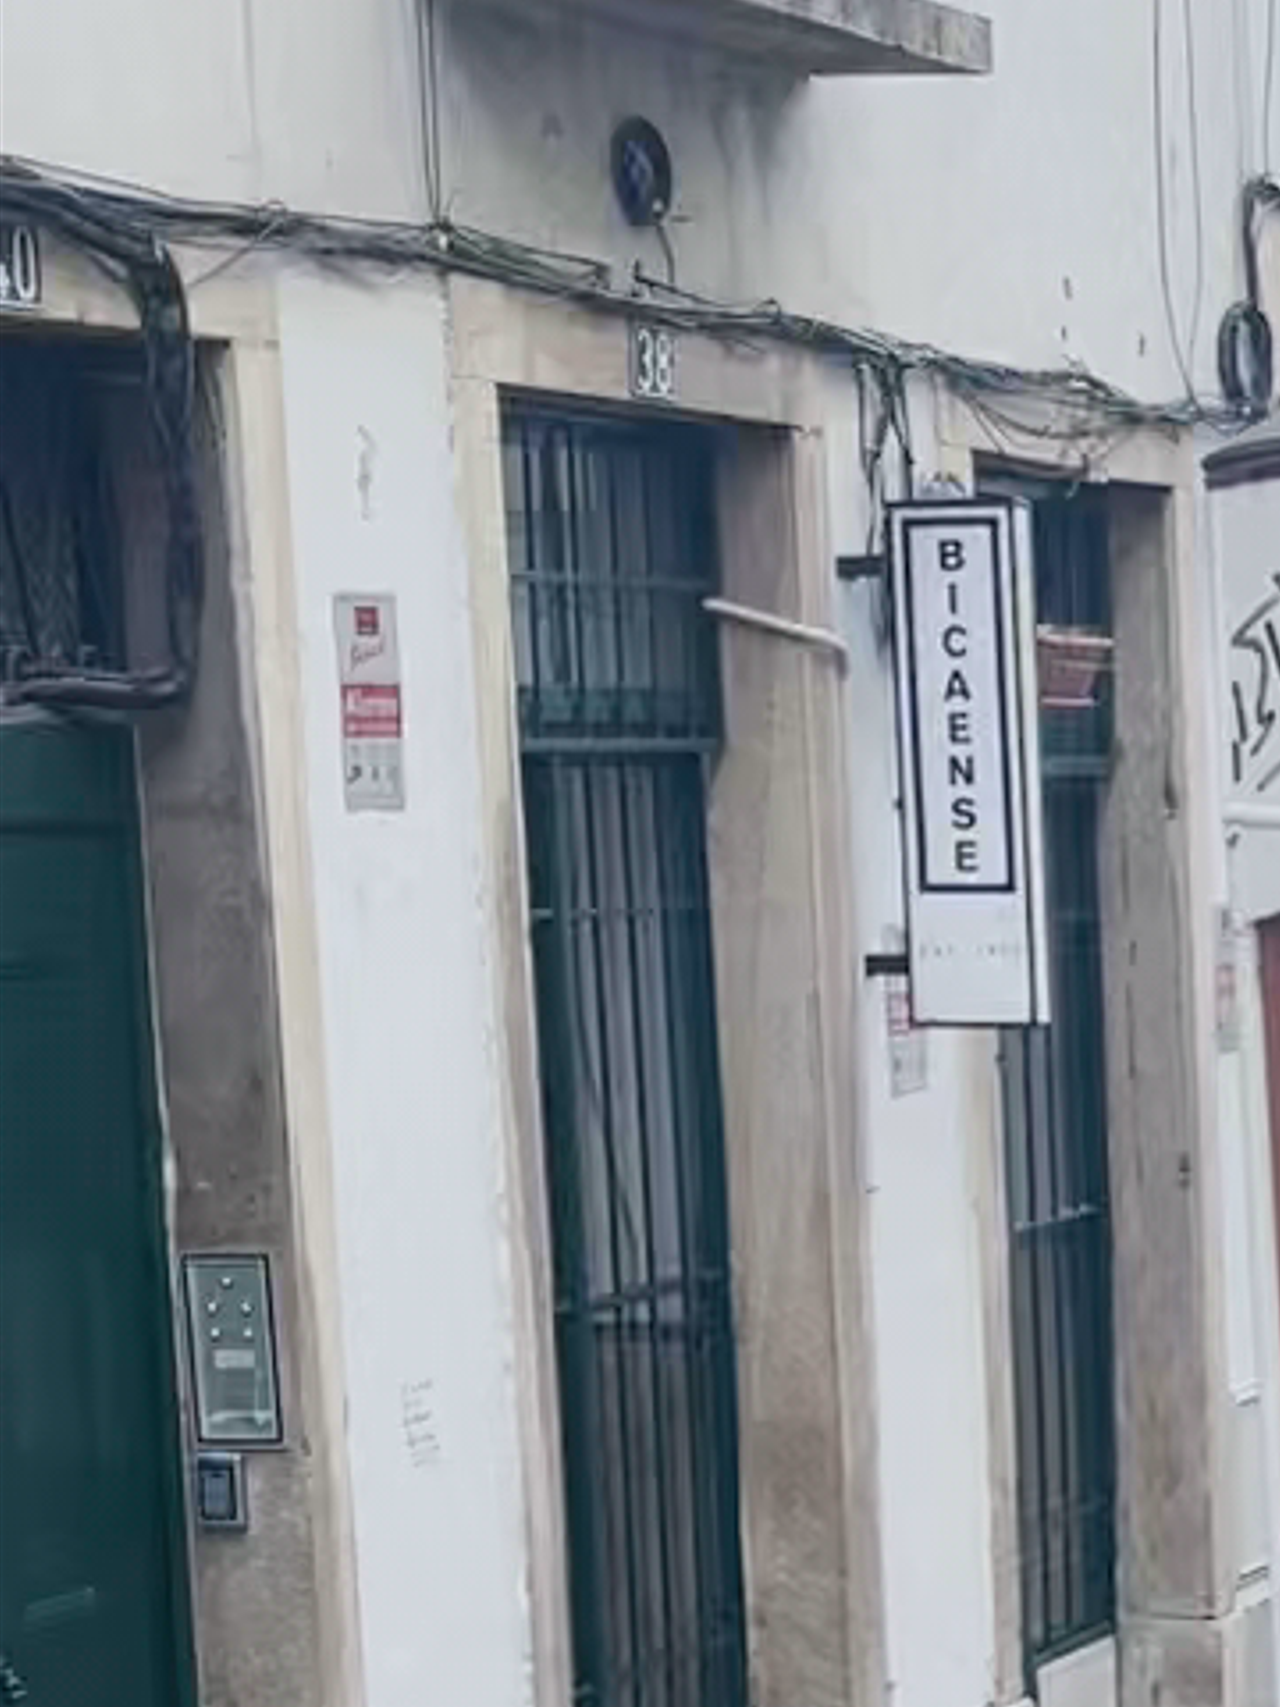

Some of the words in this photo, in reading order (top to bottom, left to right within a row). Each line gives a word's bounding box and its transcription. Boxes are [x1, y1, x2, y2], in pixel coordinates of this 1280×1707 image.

[0, 226, 36, 299] 0
[637, 328, 672, 394] 38
[938, 538, 979, 874] BICAENSE
